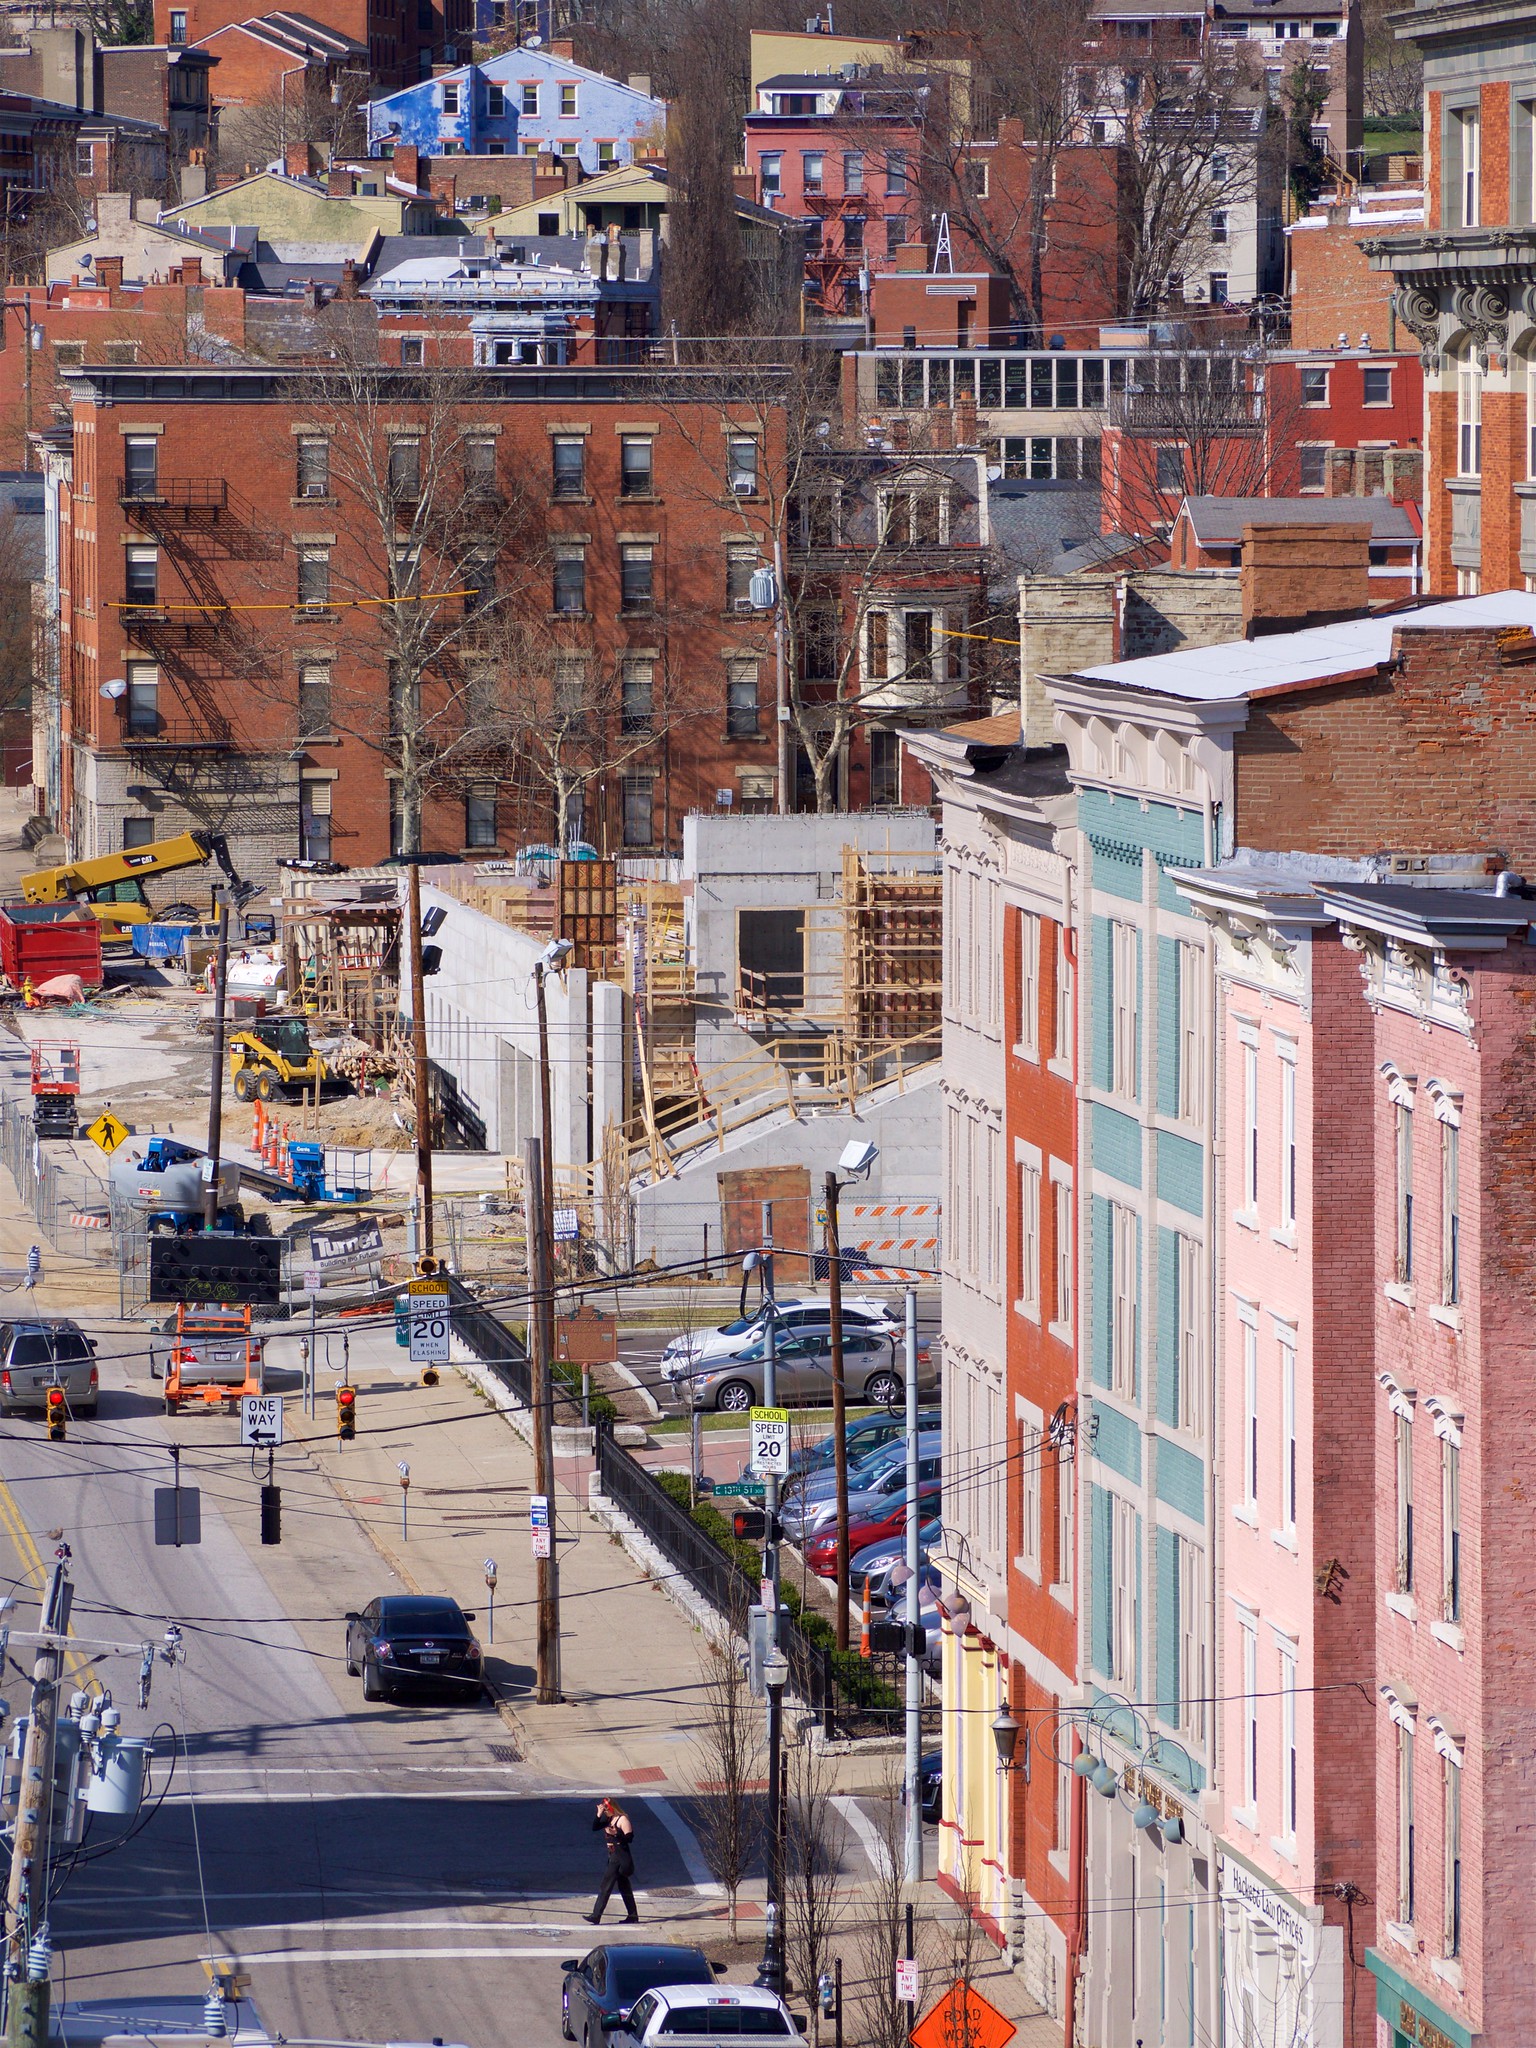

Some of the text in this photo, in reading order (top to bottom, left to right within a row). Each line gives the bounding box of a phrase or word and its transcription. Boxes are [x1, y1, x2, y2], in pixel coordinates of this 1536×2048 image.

[141, 855, 153, 864] CAT
[121, 925, 133, 934] CAT
[312, 1230, 379, 1258] Turner
[320, 1250, 379, 1268] Building the Future
[411, 1284, 446, 1293] SCHOOL
[412, 1300, 446, 1308] SPEED
[413, 1320, 446, 1338] 20
[249, 1400, 275, 1411] ONE
[248, 1414, 275, 1425] WAY
[754, 1410, 784, 1420] SCHOOL
[755, 1423, 784, 1434] SPEED
[758, 1441, 781, 1457] 20
[715, 1486, 721, 1495] E
[743, 1485, 754, 1494] ST
[1262, 1889, 1275, 1920] Law
[901, 1983, 913, 1992] TIME
[944, 2008, 982, 2022] ROAD
[945, 2027, 982, 2041] WORK
